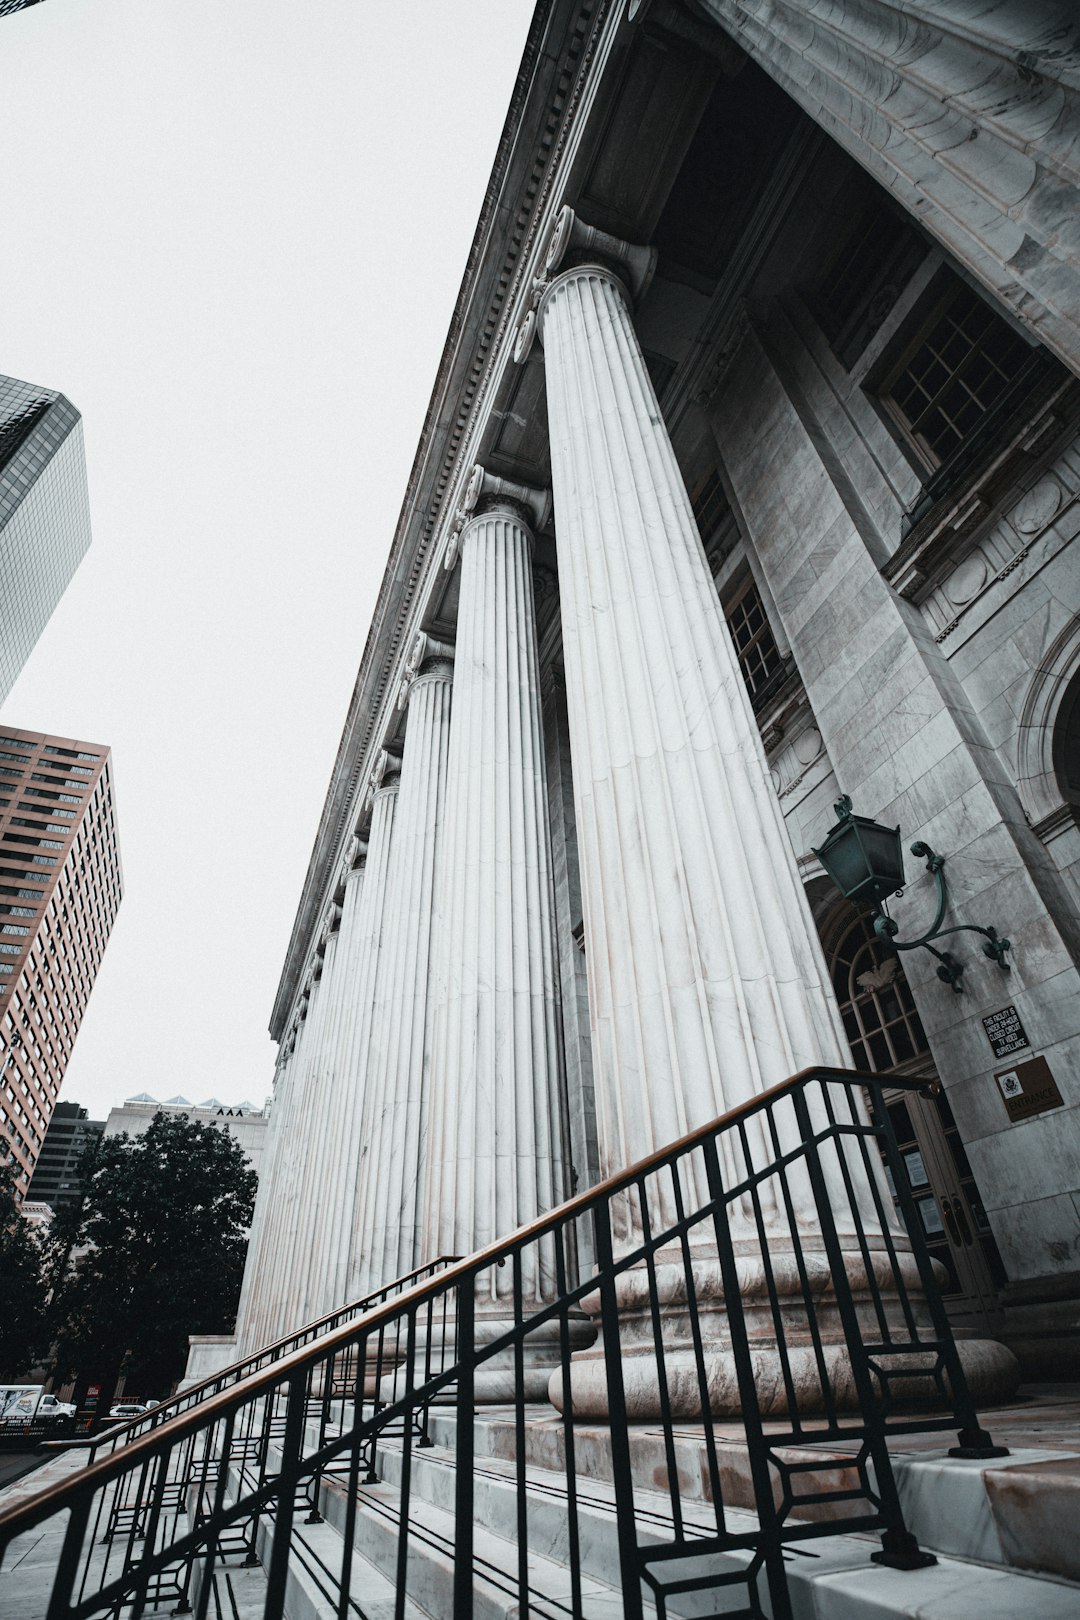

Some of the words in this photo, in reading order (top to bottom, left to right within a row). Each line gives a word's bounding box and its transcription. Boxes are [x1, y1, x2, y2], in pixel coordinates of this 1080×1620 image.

[984, 1017, 993, 1026] THIS
[993, 1010, 1009, 1022] FACILITY
[1009, 1007, 1015, 1015] IS
[987, 1023, 1000, 1034] UNDER
[1000, 1014, 1018, 1028] 24-HOUR
[989, 1029, 1005, 1041] CLOSED
[1005, 1022, 1021, 1034] CIRCUIT
[998, 1038, 1005, 1046] TV
[1006, 1032, 1017, 1043] VIDEO
[996, 1037, 1026, 1056] SURVEILLANCE
[1008, 1087, 1055, 1111] ENTRANCE
